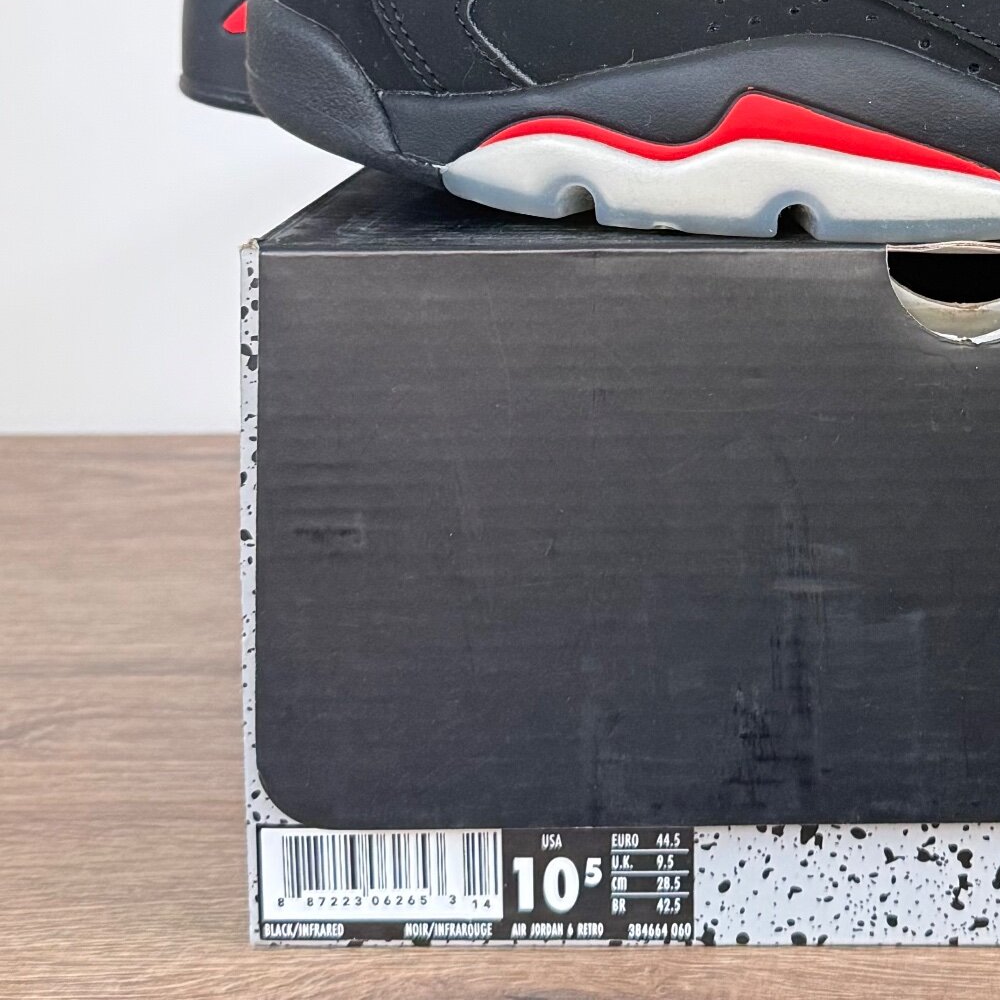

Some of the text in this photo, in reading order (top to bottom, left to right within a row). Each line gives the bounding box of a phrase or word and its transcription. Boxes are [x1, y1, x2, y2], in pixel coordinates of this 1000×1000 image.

[541, 834, 562, 849] USA
[611, 833, 681, 848] EURO 44.5
[611, 855, 674, 870] U.K. 9.5
[512, 856, 580, 914] 10
[656, 876, 681, 891] 28.5
[278, 897, 285, 906] 8
[450, 895, 457, 904] 3
[473, 899, 491, 908] 14
[611, 898, 681, 914] BR 42.5
[264, 923, 345, 937] BLACK/INFRARED
[404, 922, 493, 937] NOIR/INFRAROUGE
[511, 923, 604, 938] AIR JORDAN 6 RETRO
[628, 923, 692, 938] 384664 060
